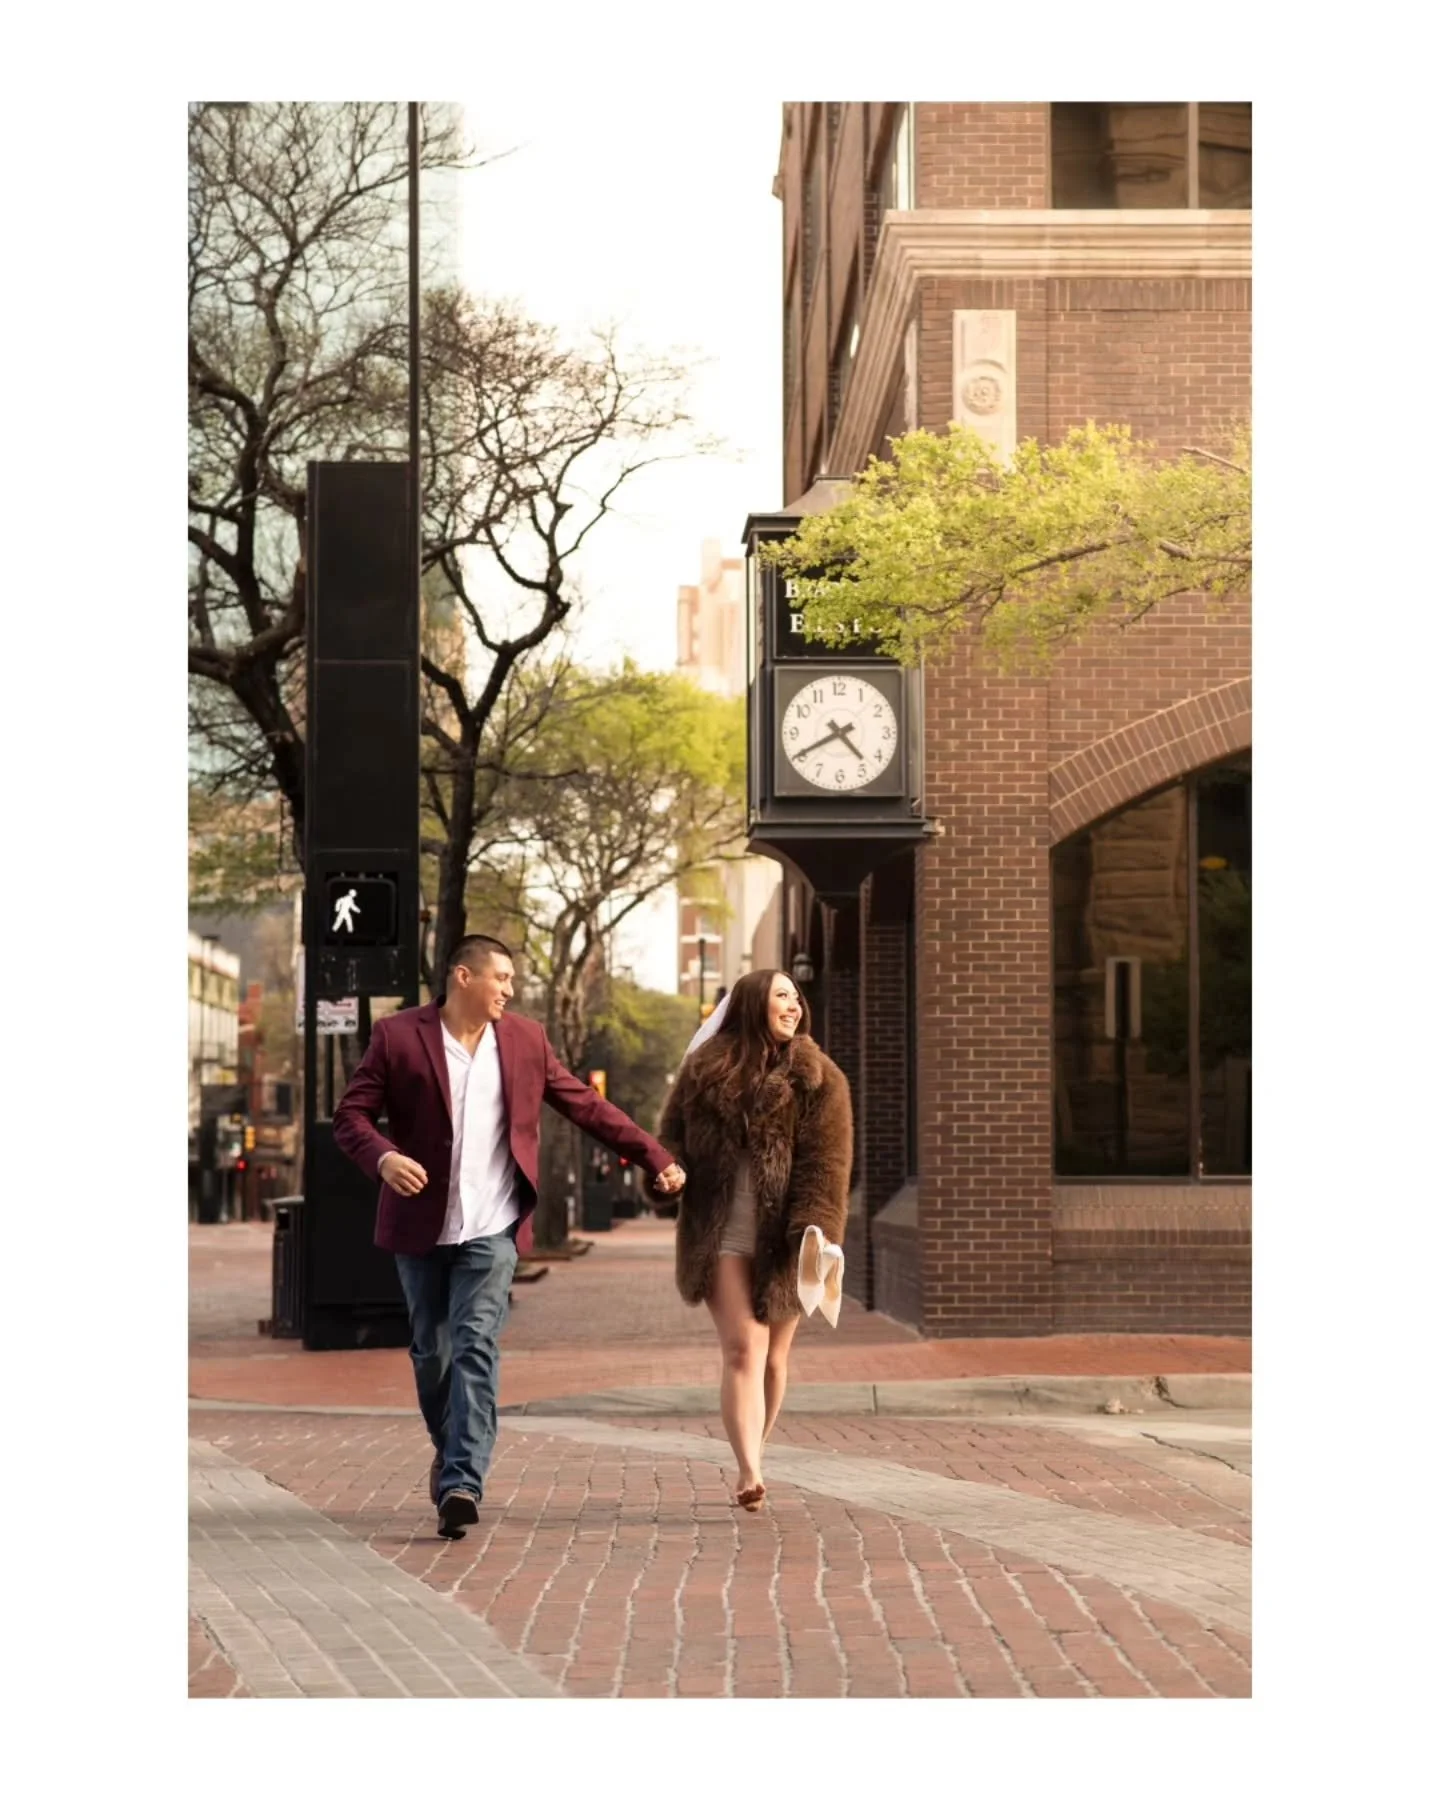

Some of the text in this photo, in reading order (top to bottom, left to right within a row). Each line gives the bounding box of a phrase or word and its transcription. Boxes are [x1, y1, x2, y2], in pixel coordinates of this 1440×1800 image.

[832, 681, 846, 696] 12
[858, 687, 863, 703] 1
[813, 689, 823, 704] 11
[796, 703, 811, 719] 10
[873, 703, 883, 718] 2
[789, 726, 799, 740] 9
[882, 725, 891, 740] 3
[874, 749, 883, 763] 4
[816, 763, 823, 778] 7
[835, 769, 845, 784] 6
[857, 763, 867, 778] 5
